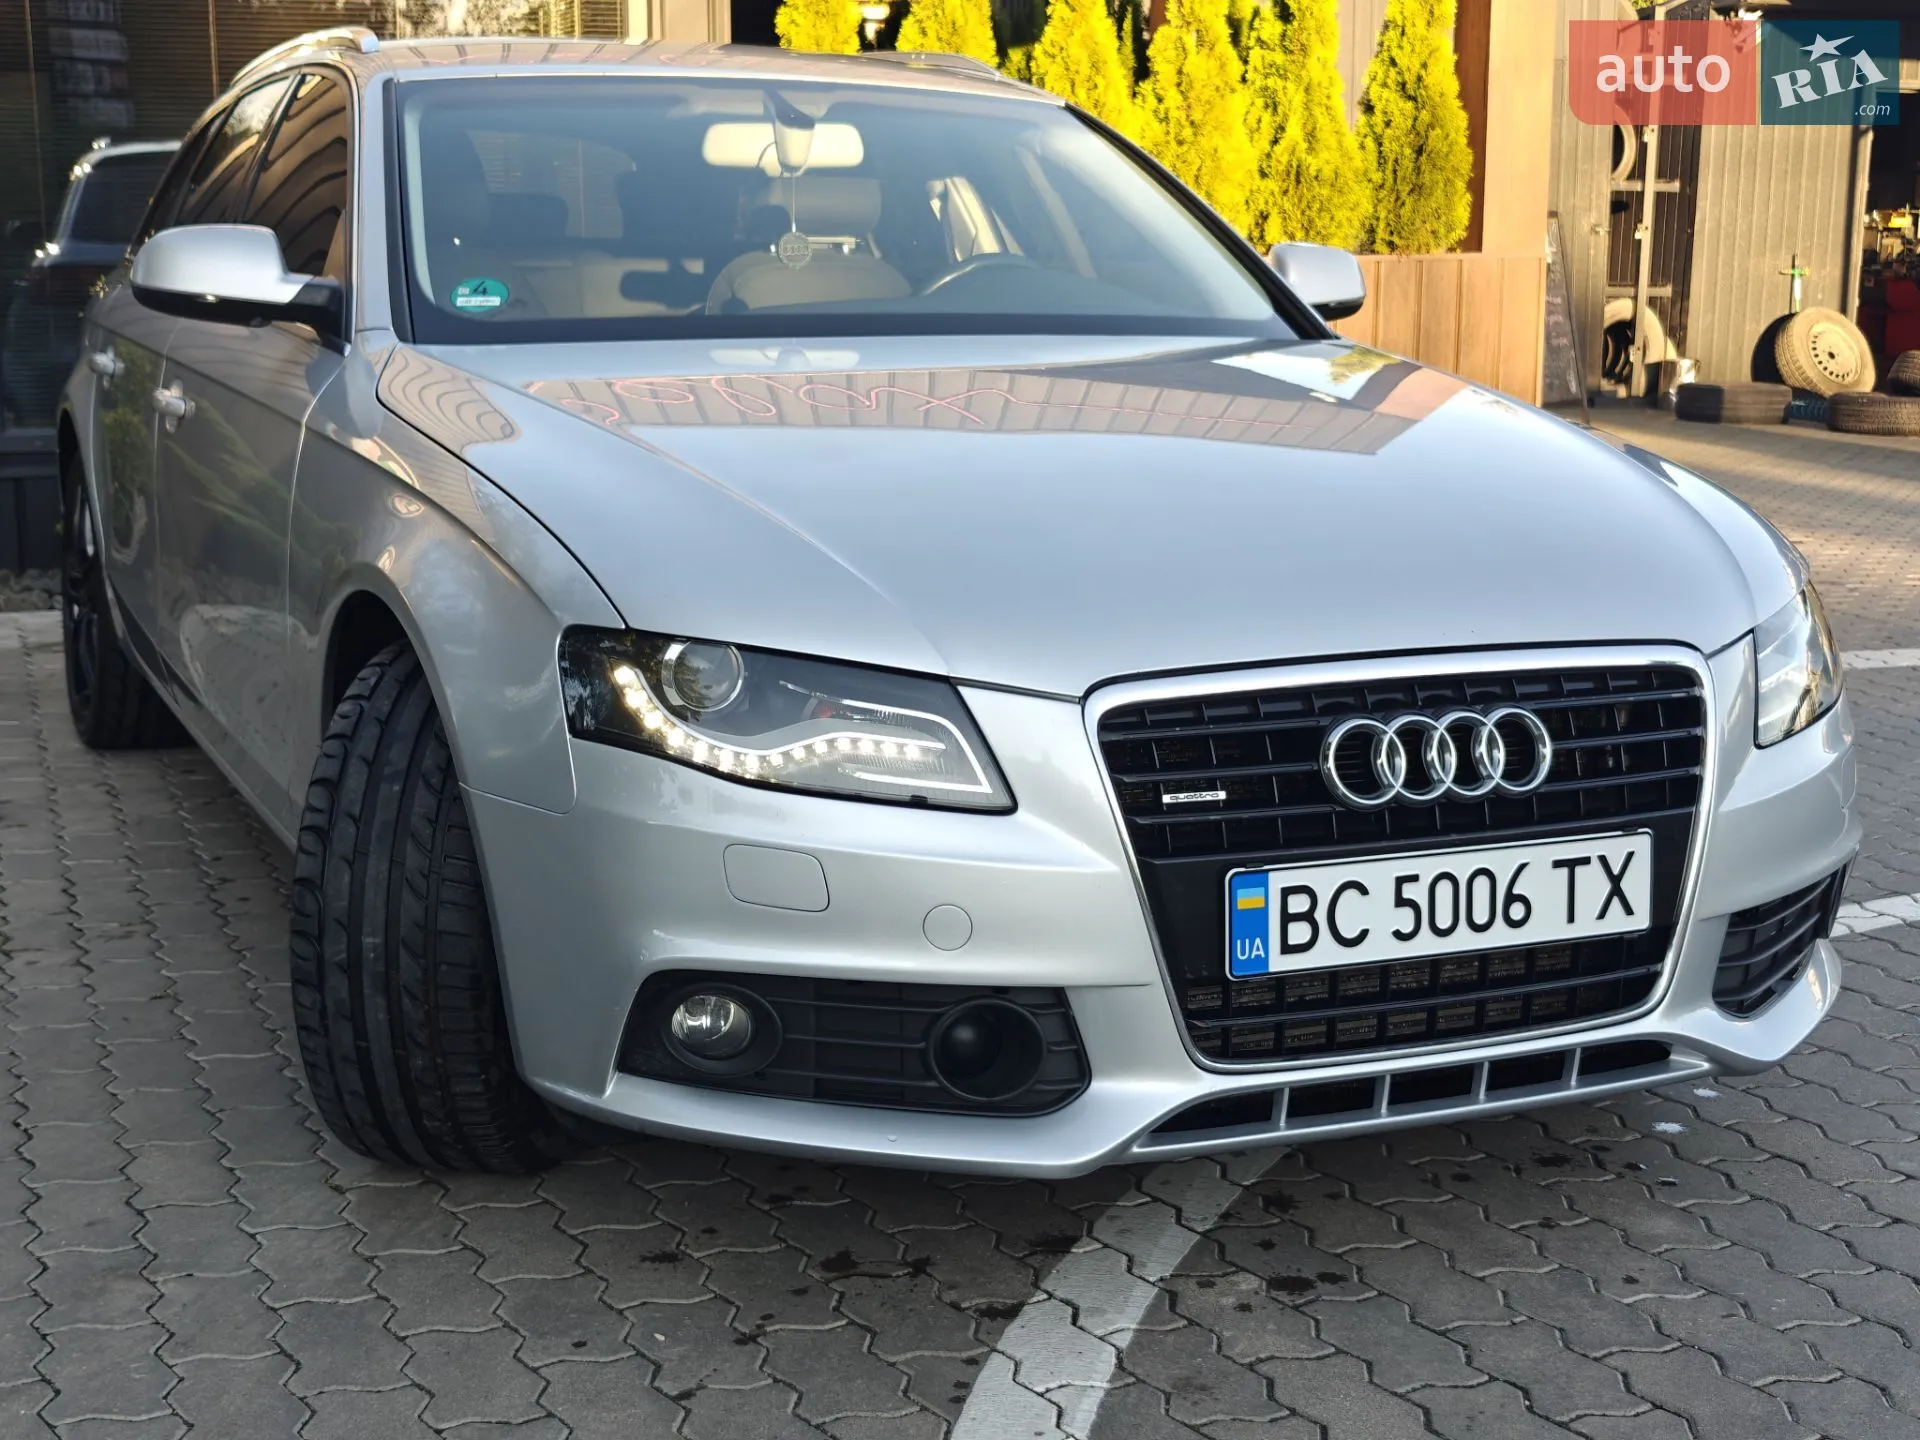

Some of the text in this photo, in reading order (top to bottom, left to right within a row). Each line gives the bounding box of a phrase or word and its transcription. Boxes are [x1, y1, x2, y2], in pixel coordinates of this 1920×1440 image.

[1169, 792, 1220, 803] quattro
[1279, 850, 1636, 956] BC 5006 TX
[1236, 937, 1265, 961] UA
